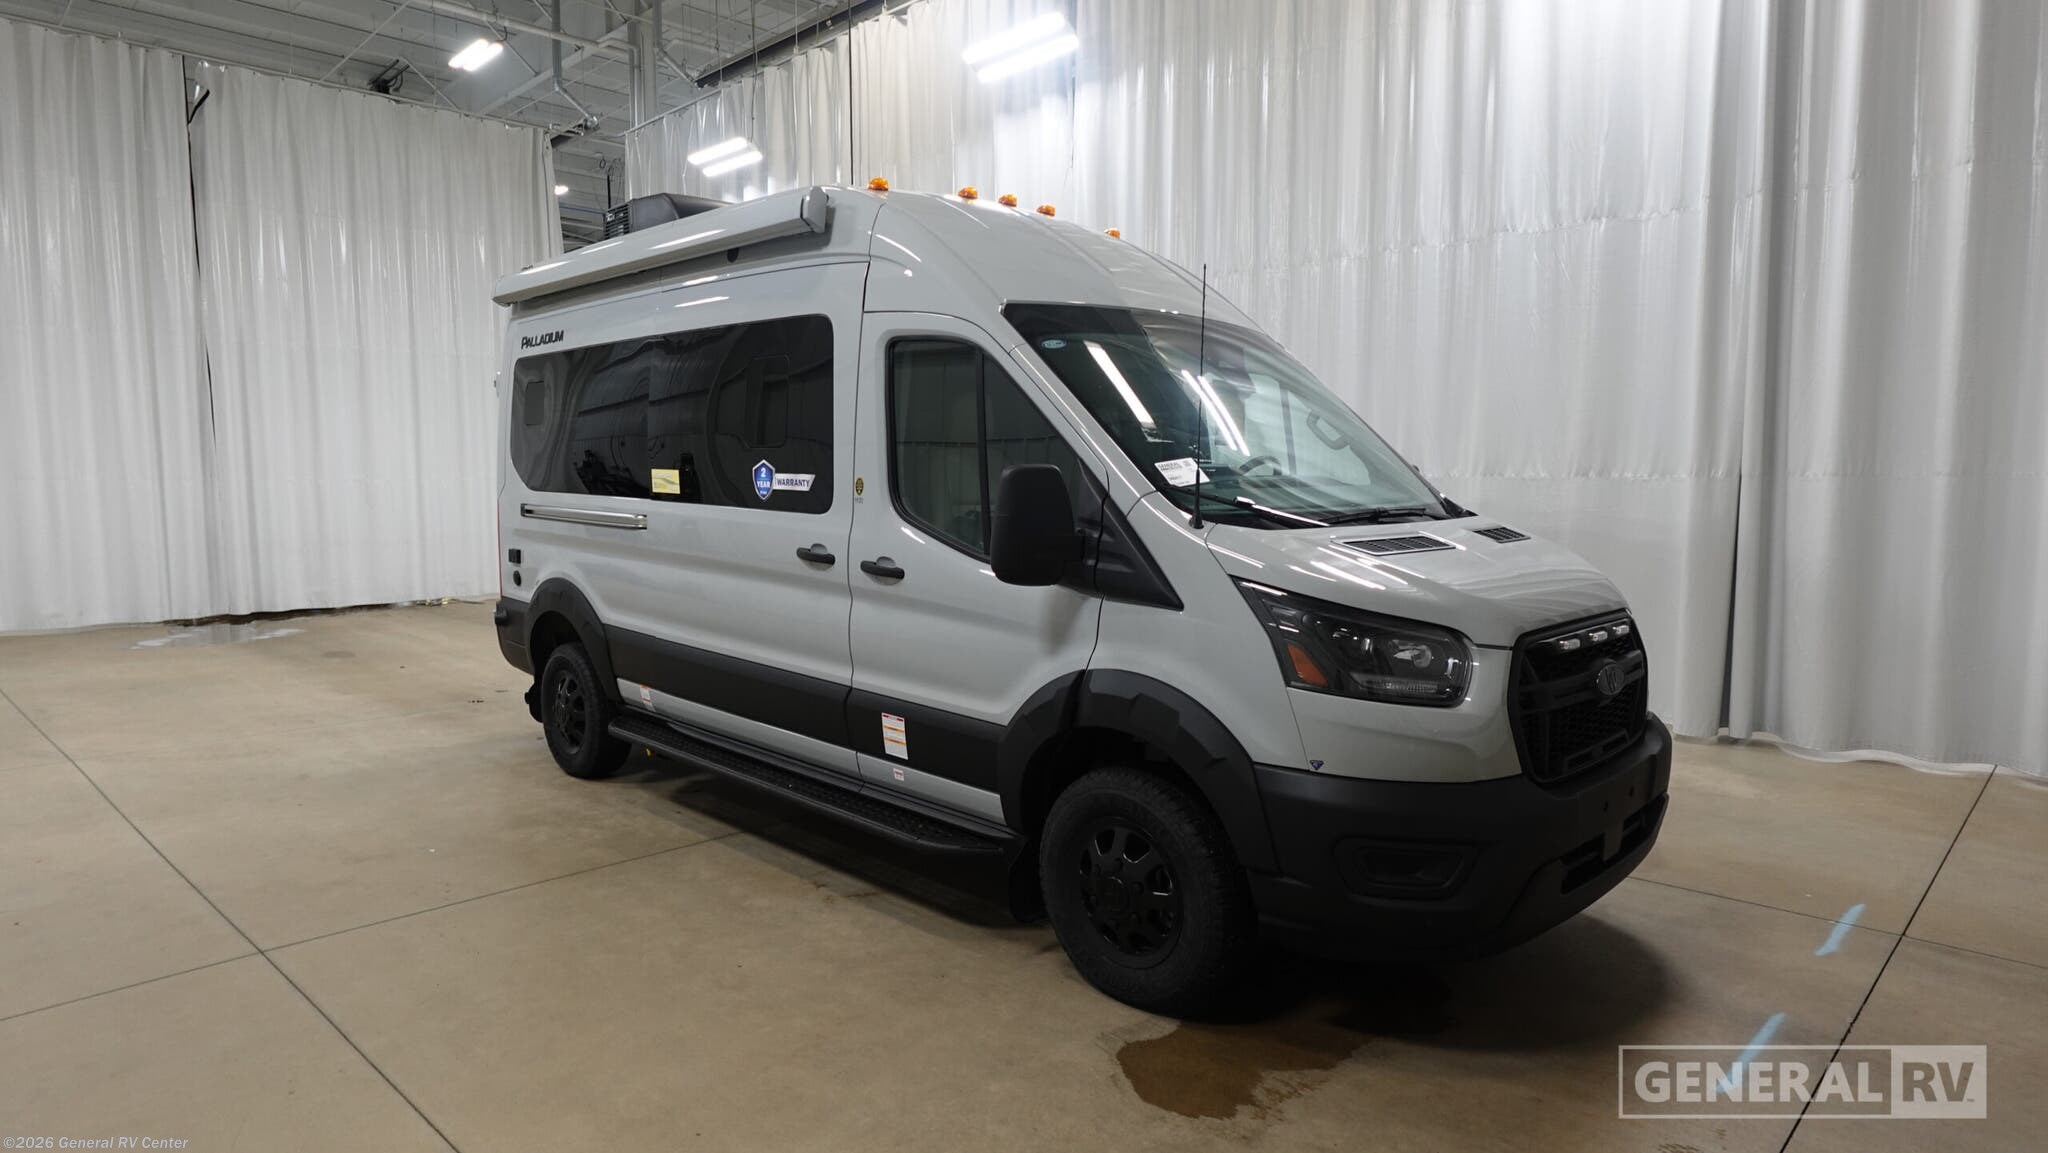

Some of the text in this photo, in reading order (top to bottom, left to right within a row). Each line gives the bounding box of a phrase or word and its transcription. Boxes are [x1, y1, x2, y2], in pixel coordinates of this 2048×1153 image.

[521, 330, 564, 350] PALLADIUM
[760, 467, 767, 478] 2
[757, 480, 771, 489] YEAR
[776, 478, 810, 488] WARRANTY
